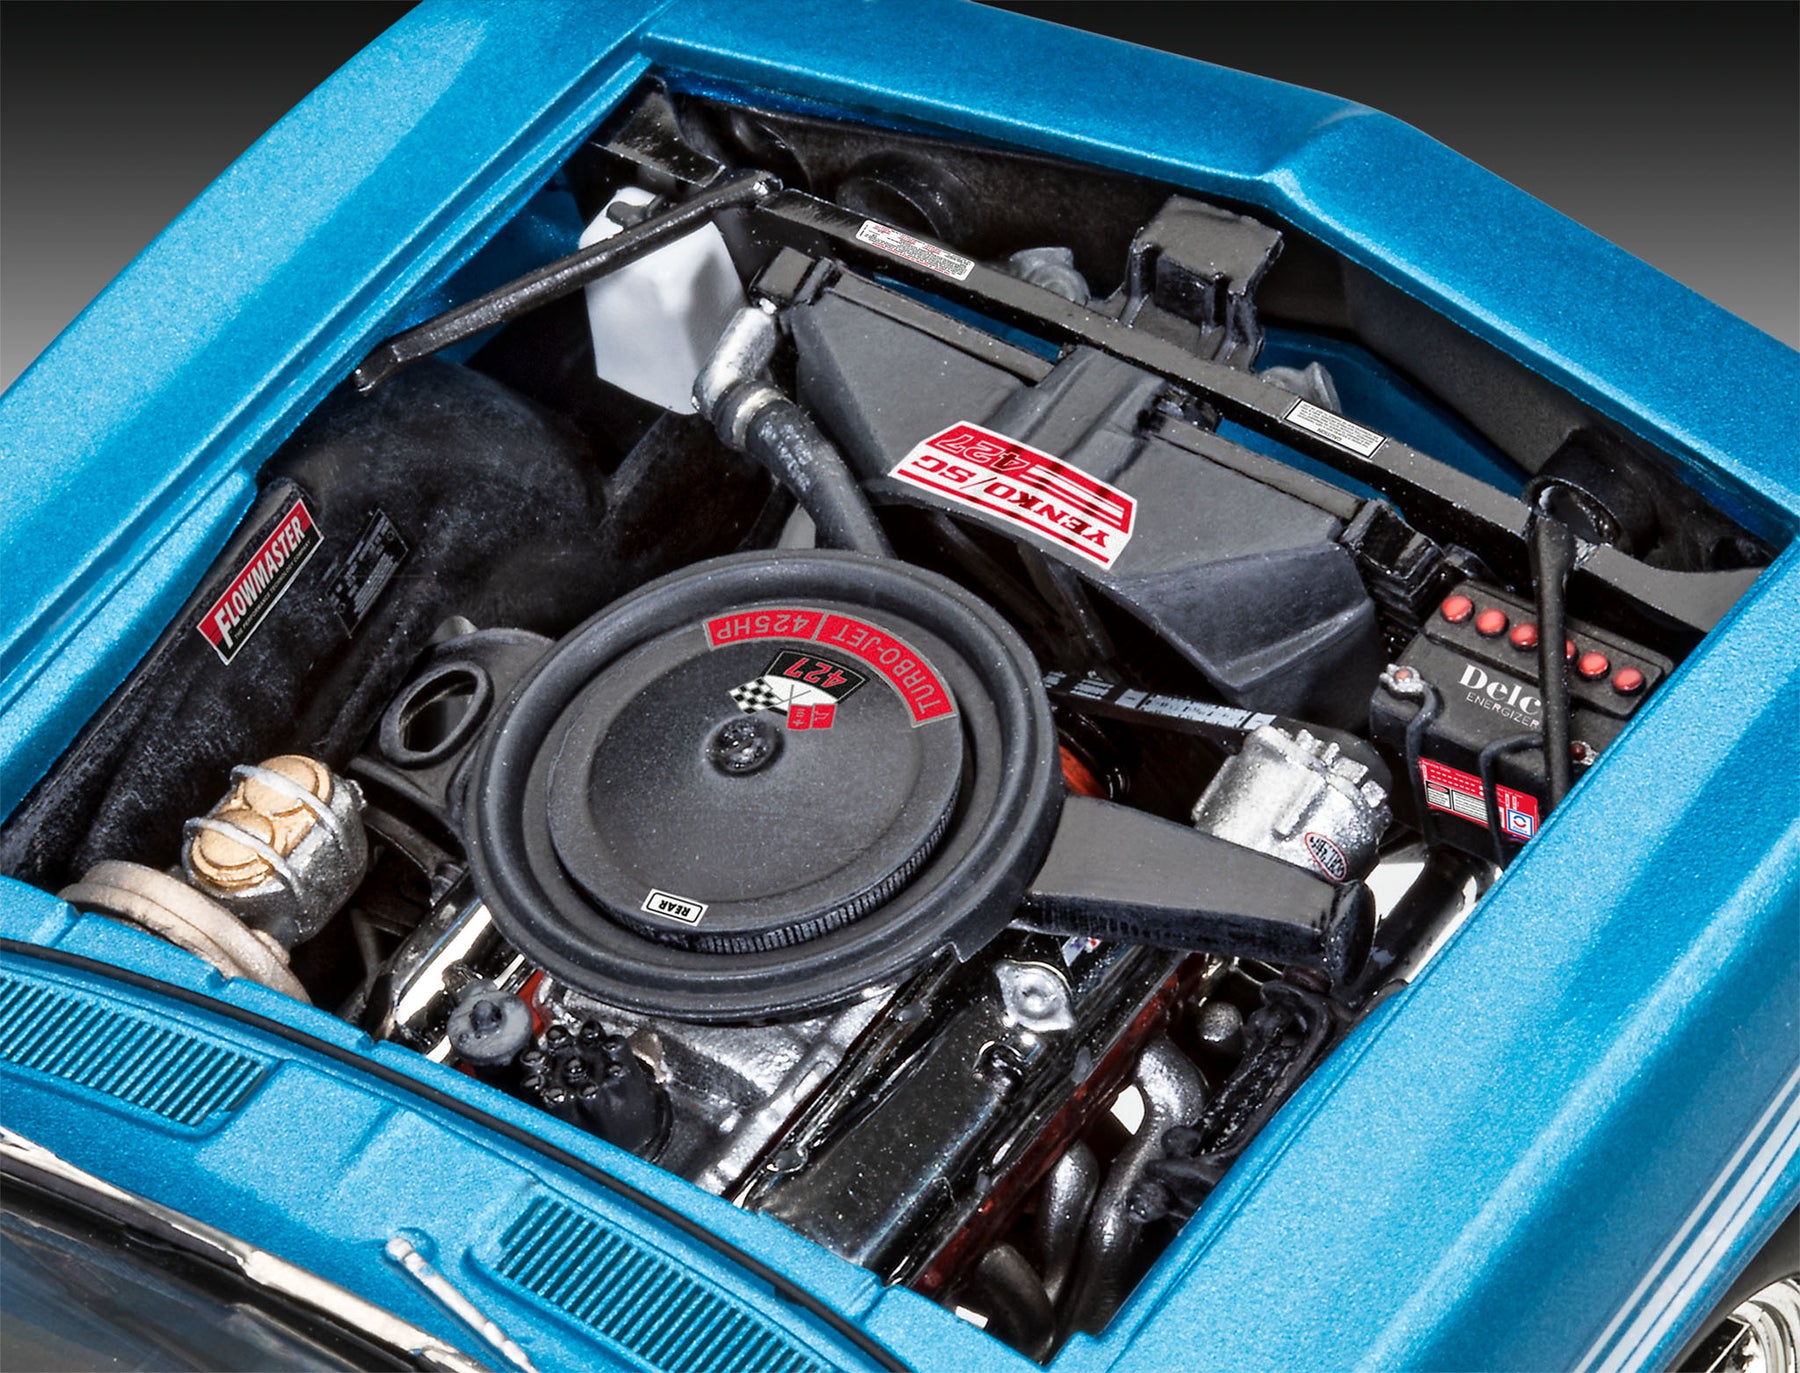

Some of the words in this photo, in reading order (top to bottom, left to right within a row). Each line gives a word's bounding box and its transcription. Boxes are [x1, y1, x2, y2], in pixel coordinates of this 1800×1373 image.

[935, 433, 1031, 473] 427
[911, 454, 1110, 548] YENKO/SC
[214, 515, 305, 649] FLOWMASTER
[716, 613, 810, 640] 425HP
[783, 657, 848, 688] 427
[832, 624, 941, 714] TURBO-JET
[1457, 663, 1542, 716] Delc
[1466, 692, 1540, 729] ENERGIZER
[658, 899, 691, 917] REAR
